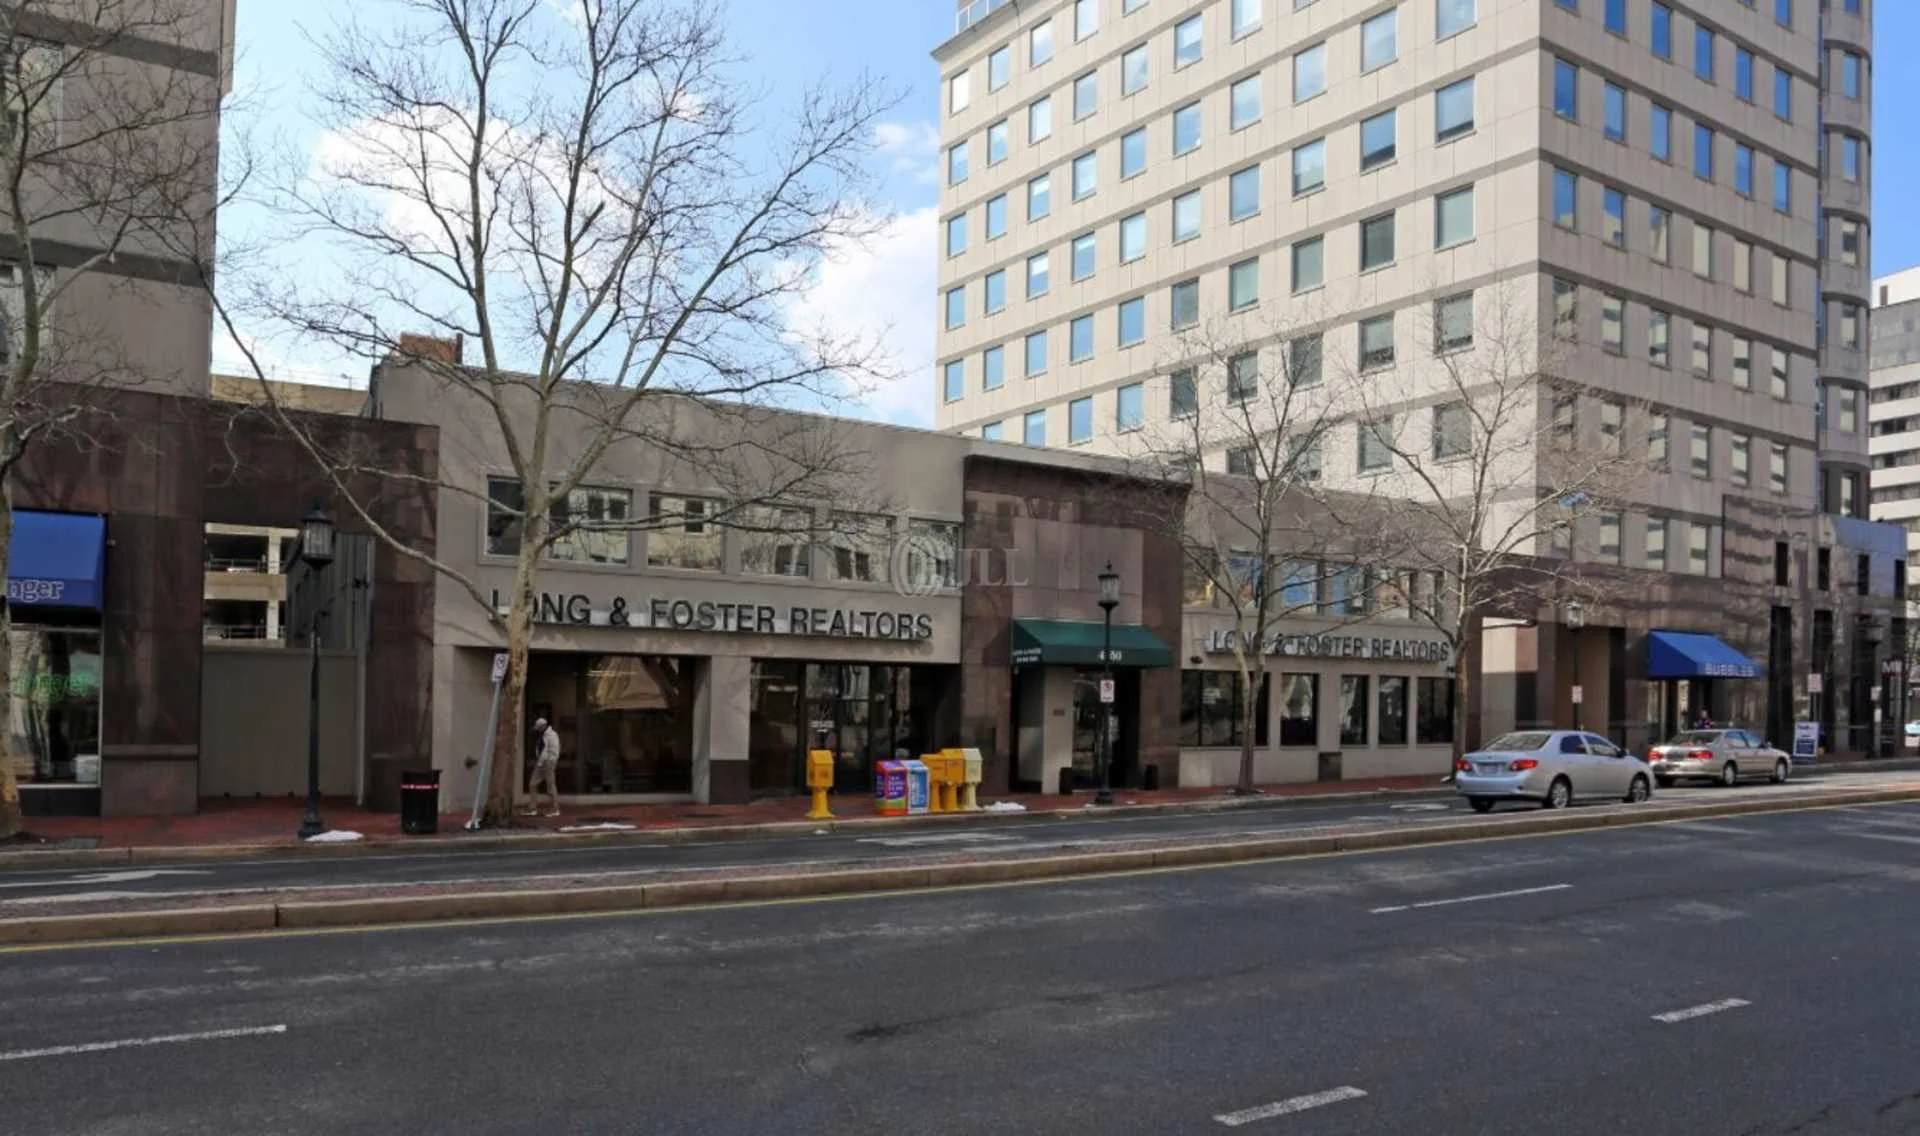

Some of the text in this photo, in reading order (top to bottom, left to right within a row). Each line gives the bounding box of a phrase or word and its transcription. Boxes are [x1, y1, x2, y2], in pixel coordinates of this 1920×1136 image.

[490, 588, 933, 641] LNG & FOSTER REALTORS
[1296, 634, 1363, 657] FOSTER
[1370, 638, 1450, 661] REALTORS
